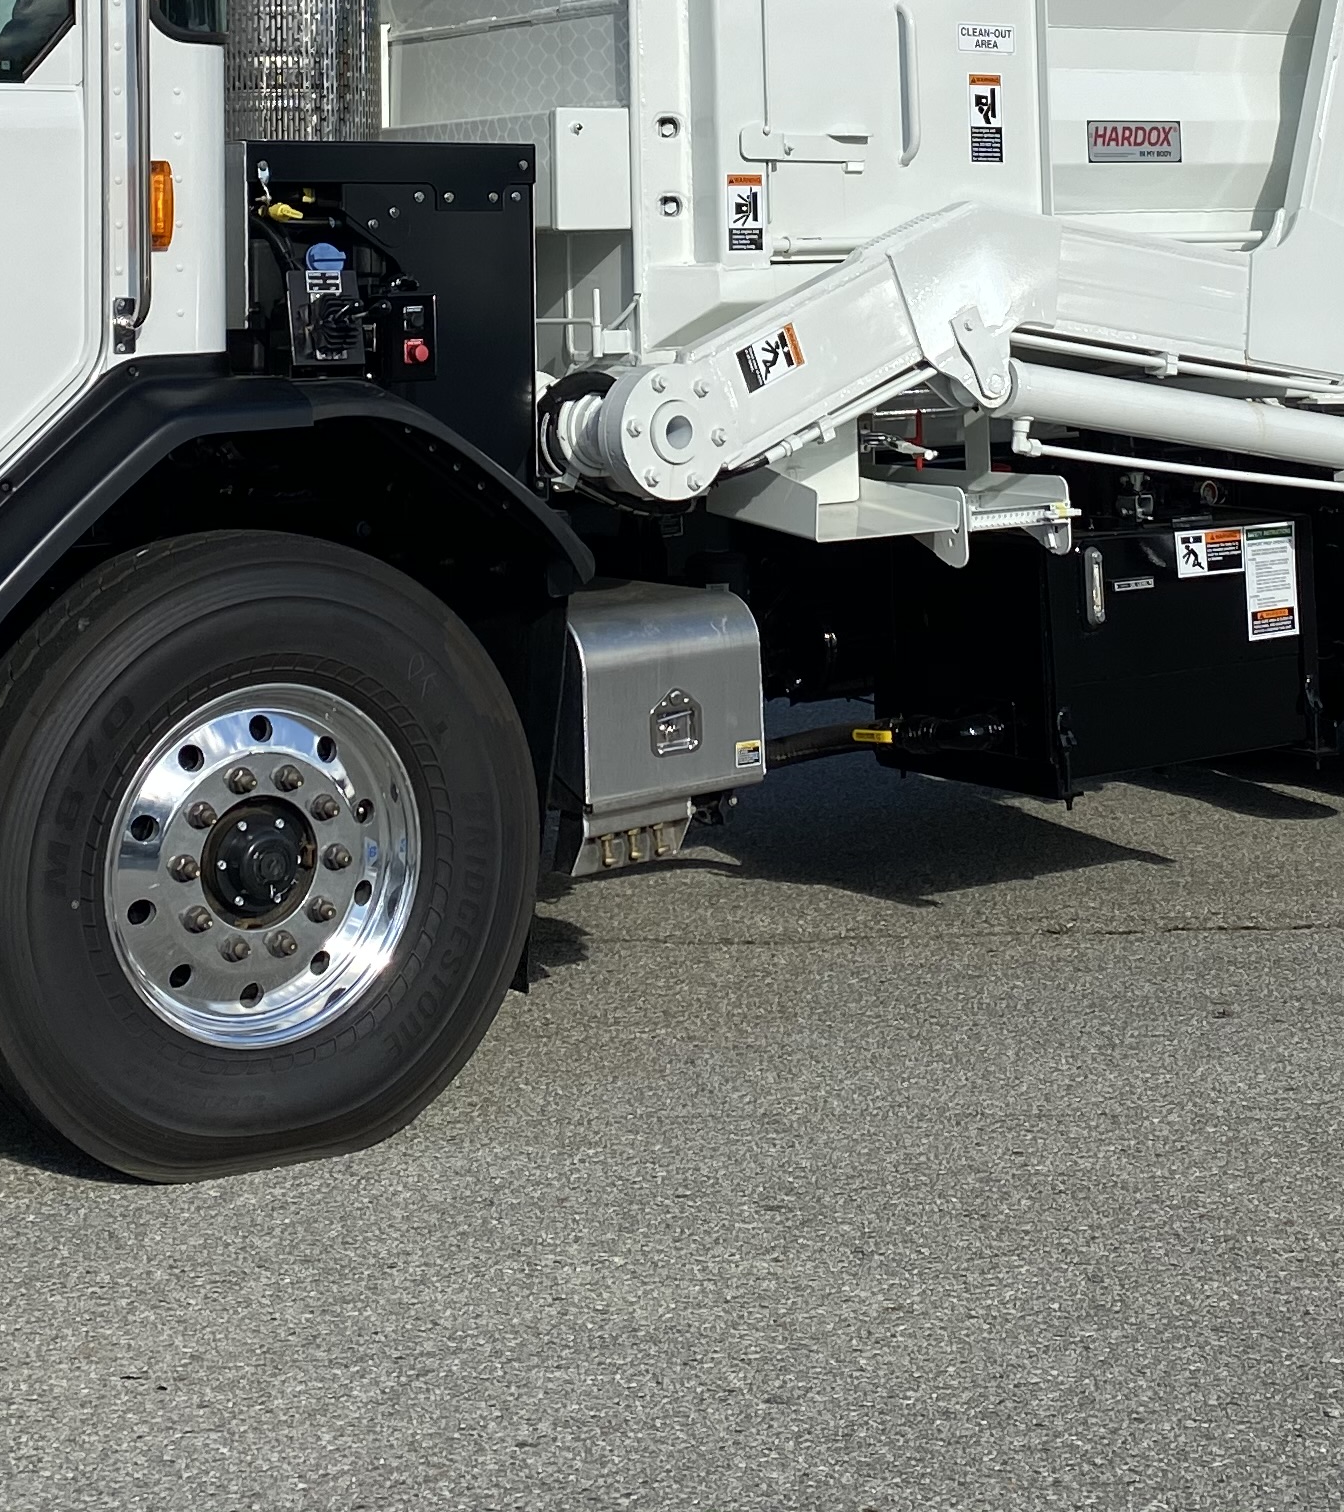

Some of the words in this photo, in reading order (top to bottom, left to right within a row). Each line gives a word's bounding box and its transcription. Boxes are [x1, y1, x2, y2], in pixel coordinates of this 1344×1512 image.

[960, 26, 1012, 39] CLEAN-OUT
[974, 39, 999, 50] AREA
[1093, 125, 1173, 147] HARDOX
[1147, 150, 1155, 158] MY
[1156, 150, 1172, 158] BODY
